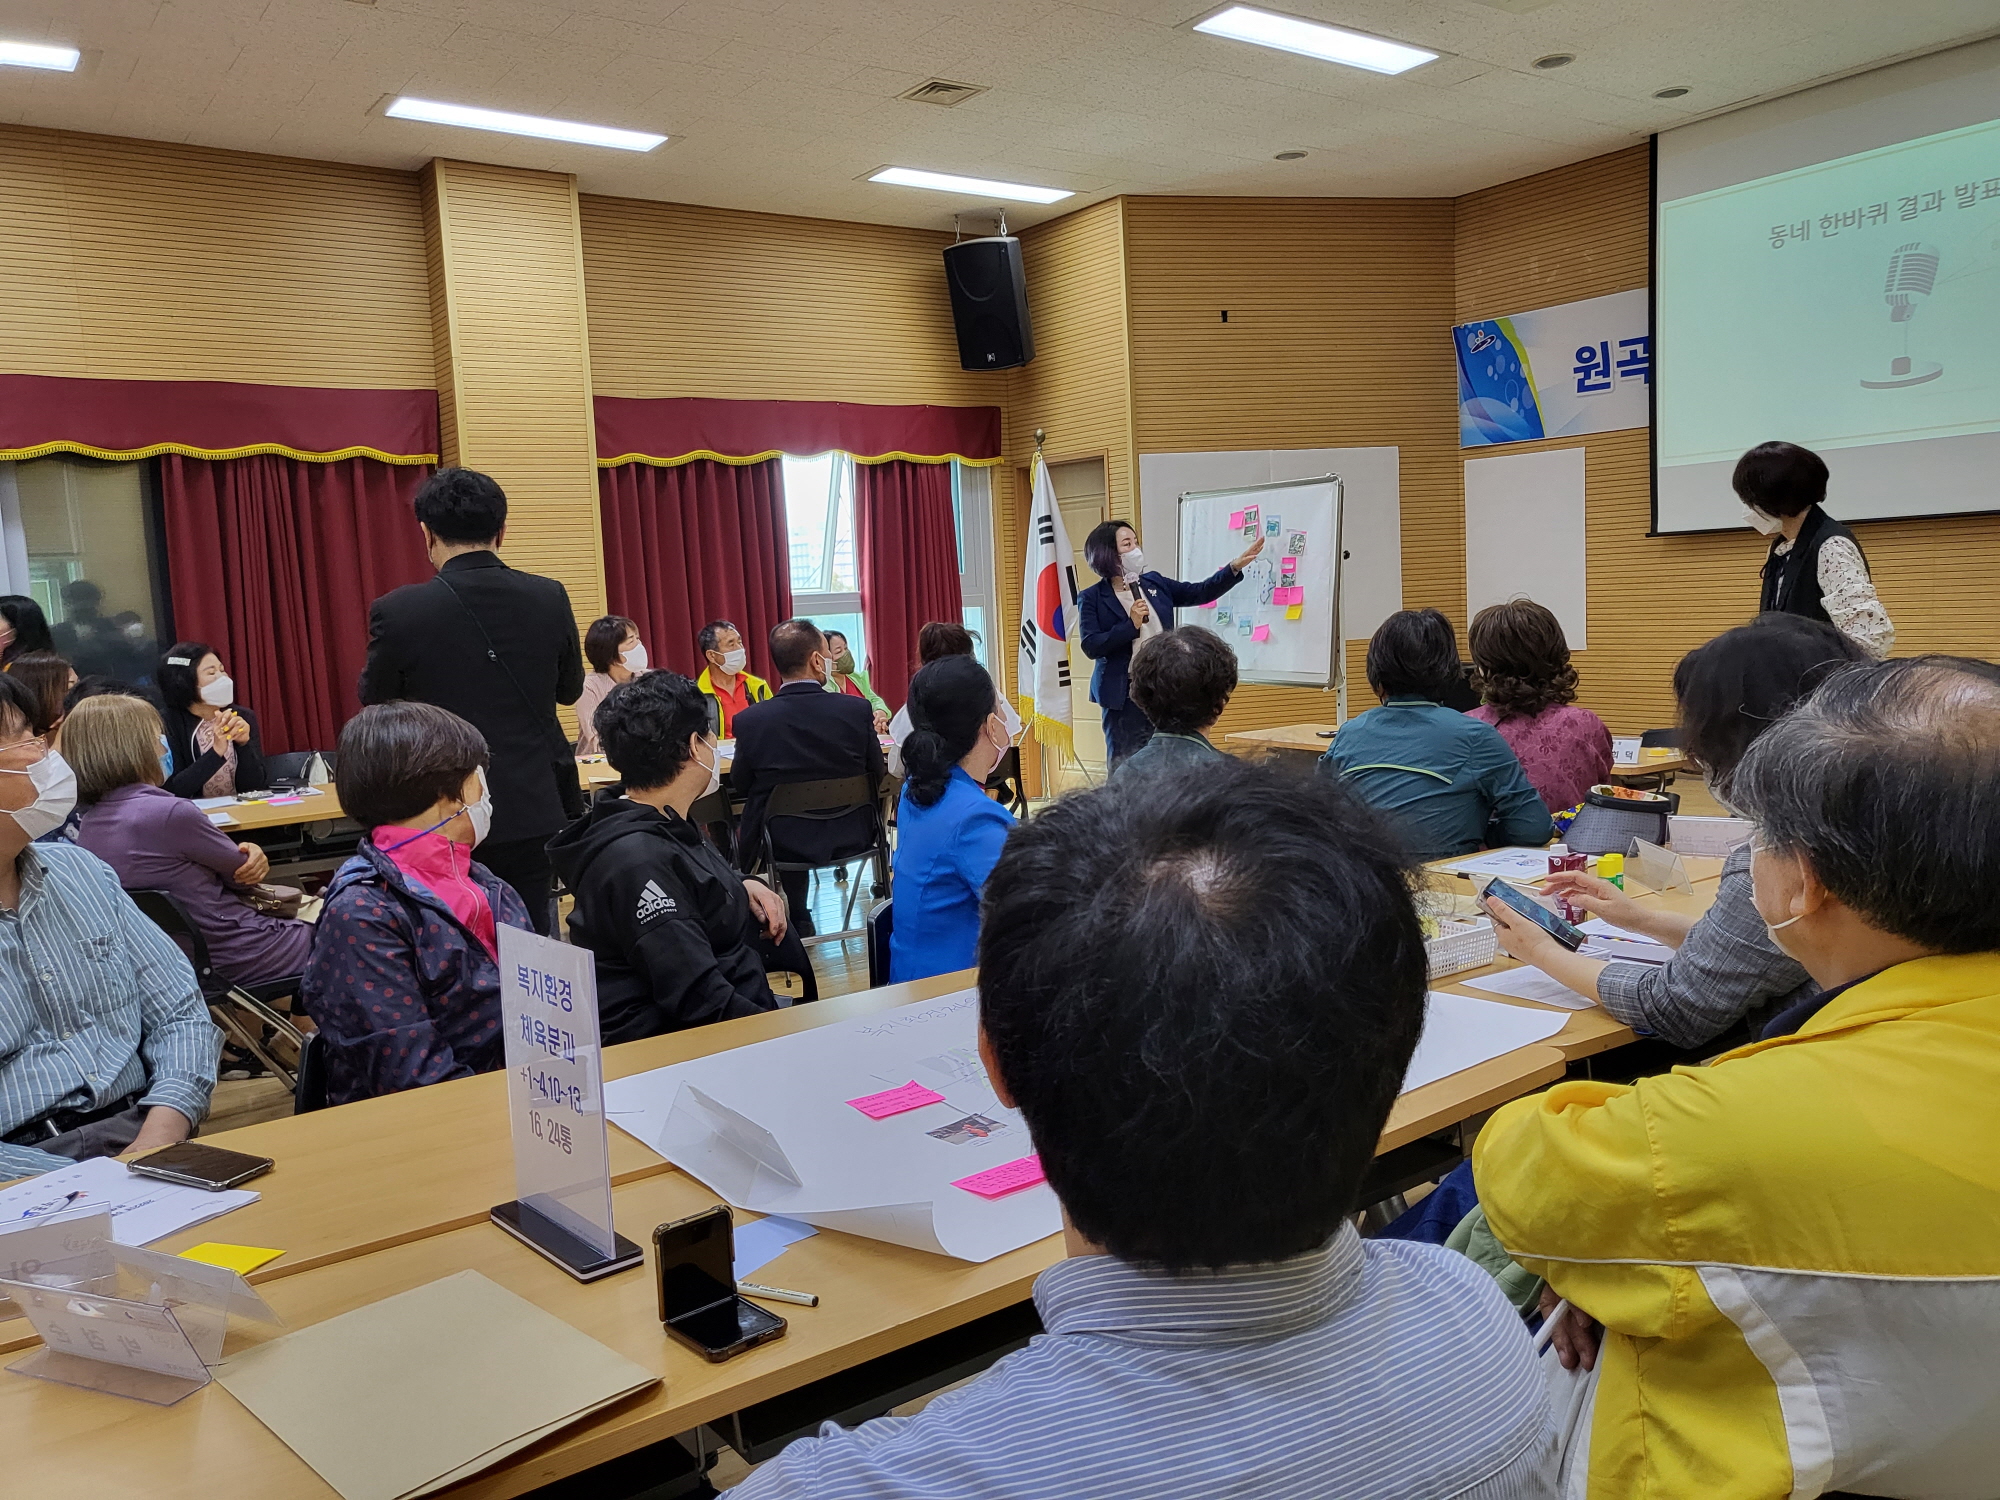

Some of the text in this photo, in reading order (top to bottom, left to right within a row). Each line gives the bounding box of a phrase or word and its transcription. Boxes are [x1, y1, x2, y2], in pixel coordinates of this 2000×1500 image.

[1767, 177, 2000, 250] 동네 한바퀴 결과 발표
[636, 897, 676, 919] adidas
[517, 963, 573, 1013] 복지환경
[520, 1013, 576, 1065] 체육분과
[529, 1109, 573, 1155] 16, 24통
